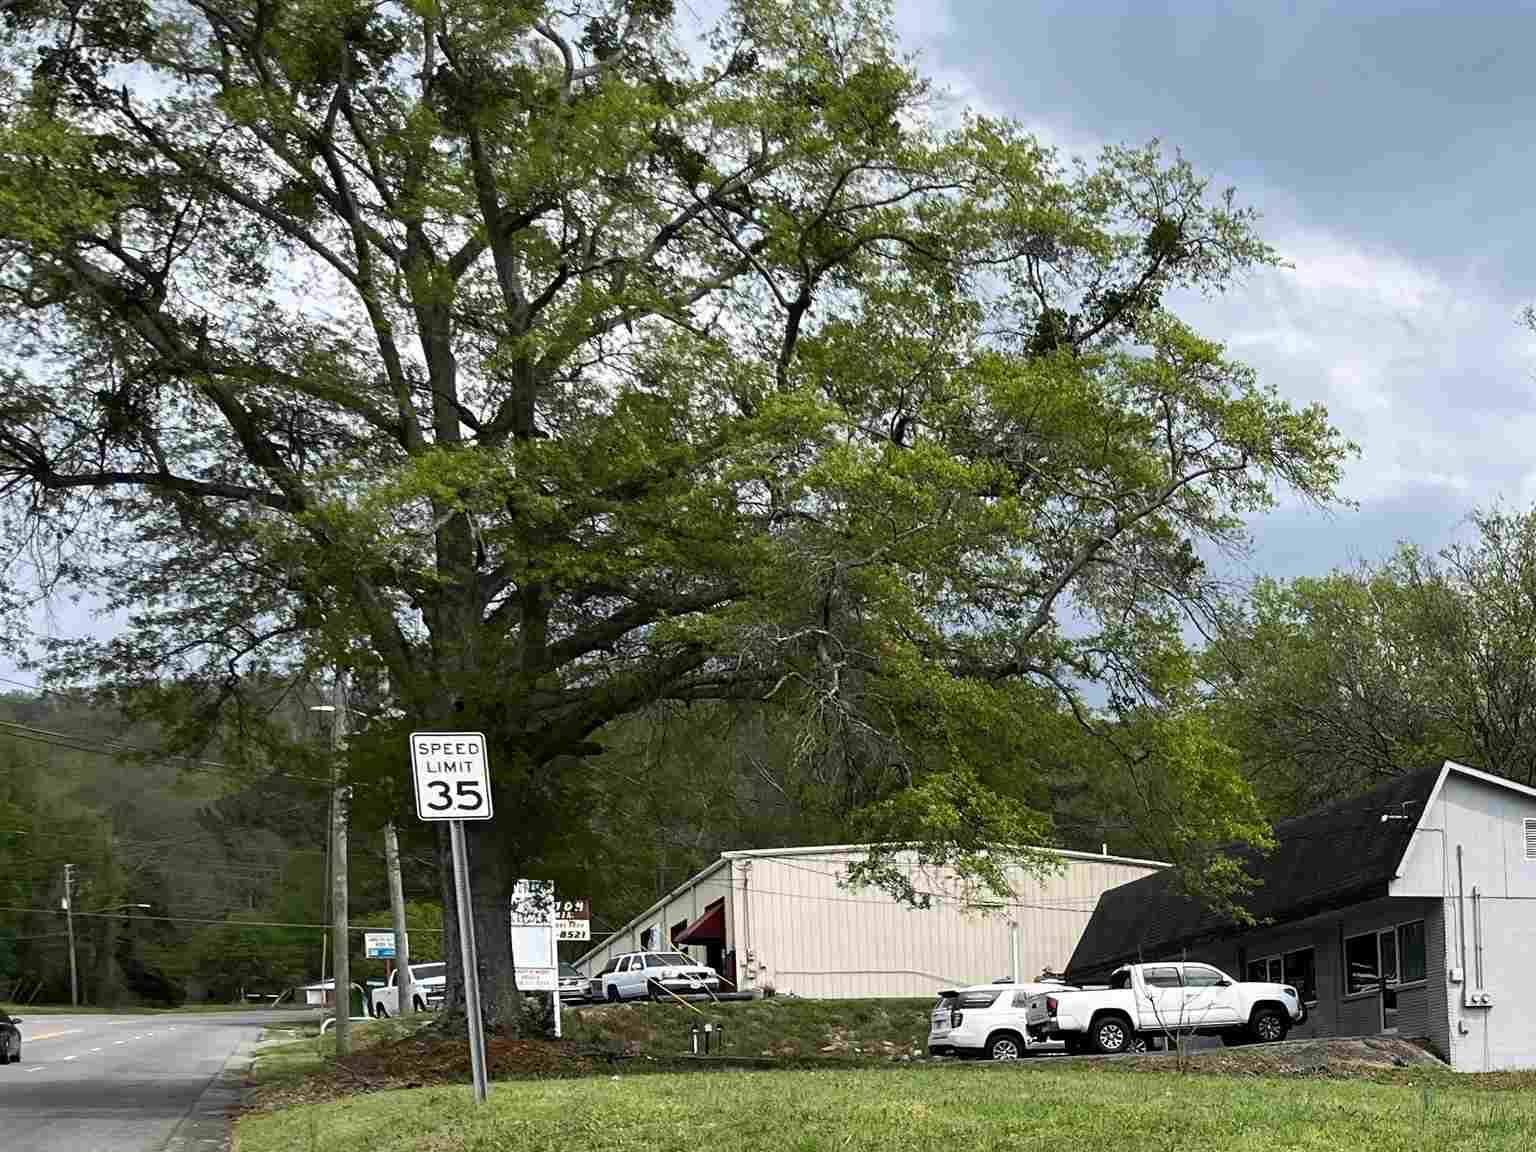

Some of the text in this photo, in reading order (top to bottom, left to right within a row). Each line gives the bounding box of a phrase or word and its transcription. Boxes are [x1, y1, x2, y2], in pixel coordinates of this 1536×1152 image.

[419, 743, 479, 755] SPEED
[426, 761, 472, 773] LIMIT
[427, 781, 483, 811] 35
